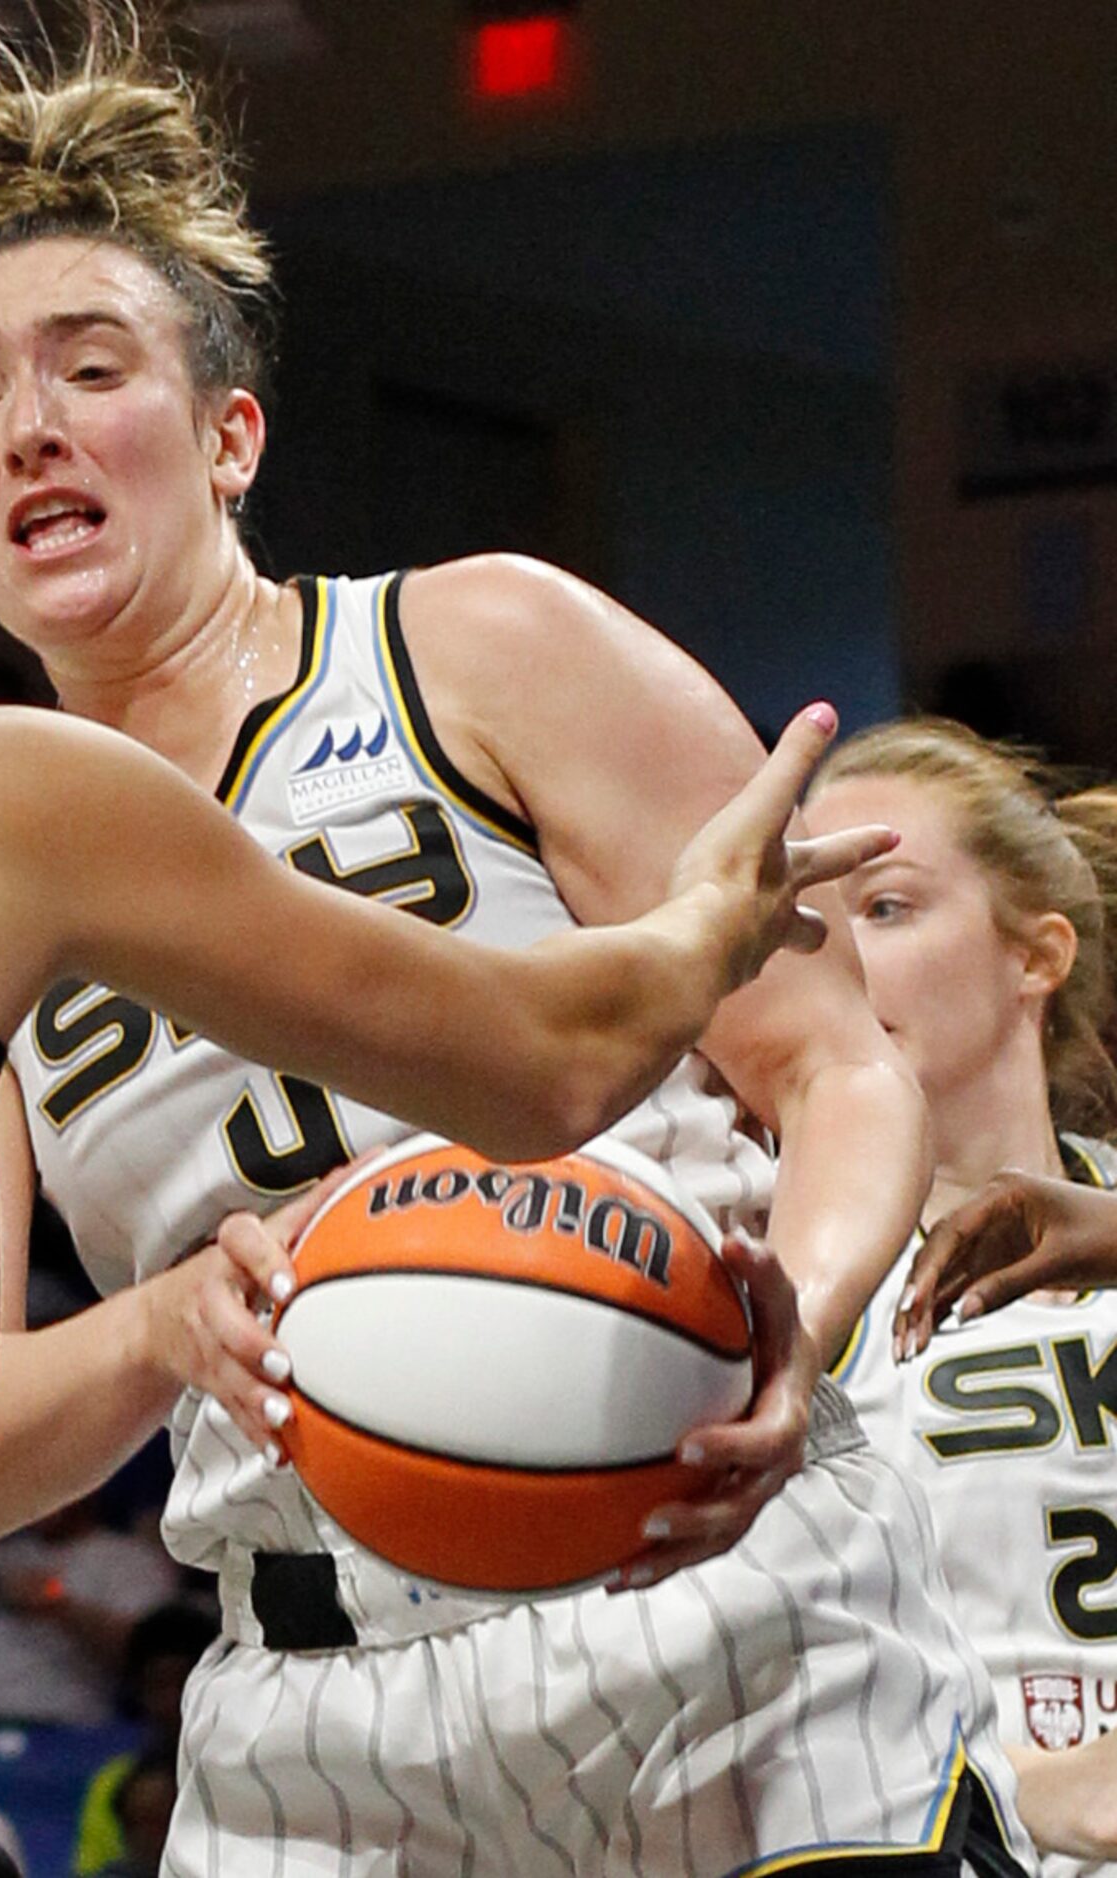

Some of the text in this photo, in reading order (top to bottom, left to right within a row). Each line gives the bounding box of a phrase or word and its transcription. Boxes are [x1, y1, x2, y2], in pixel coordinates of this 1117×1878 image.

[290, 760, 402, 798] MAGELLAN
[33, 800, 476, 1132] SY
[367, 1161, 673, 1289] Wilson
